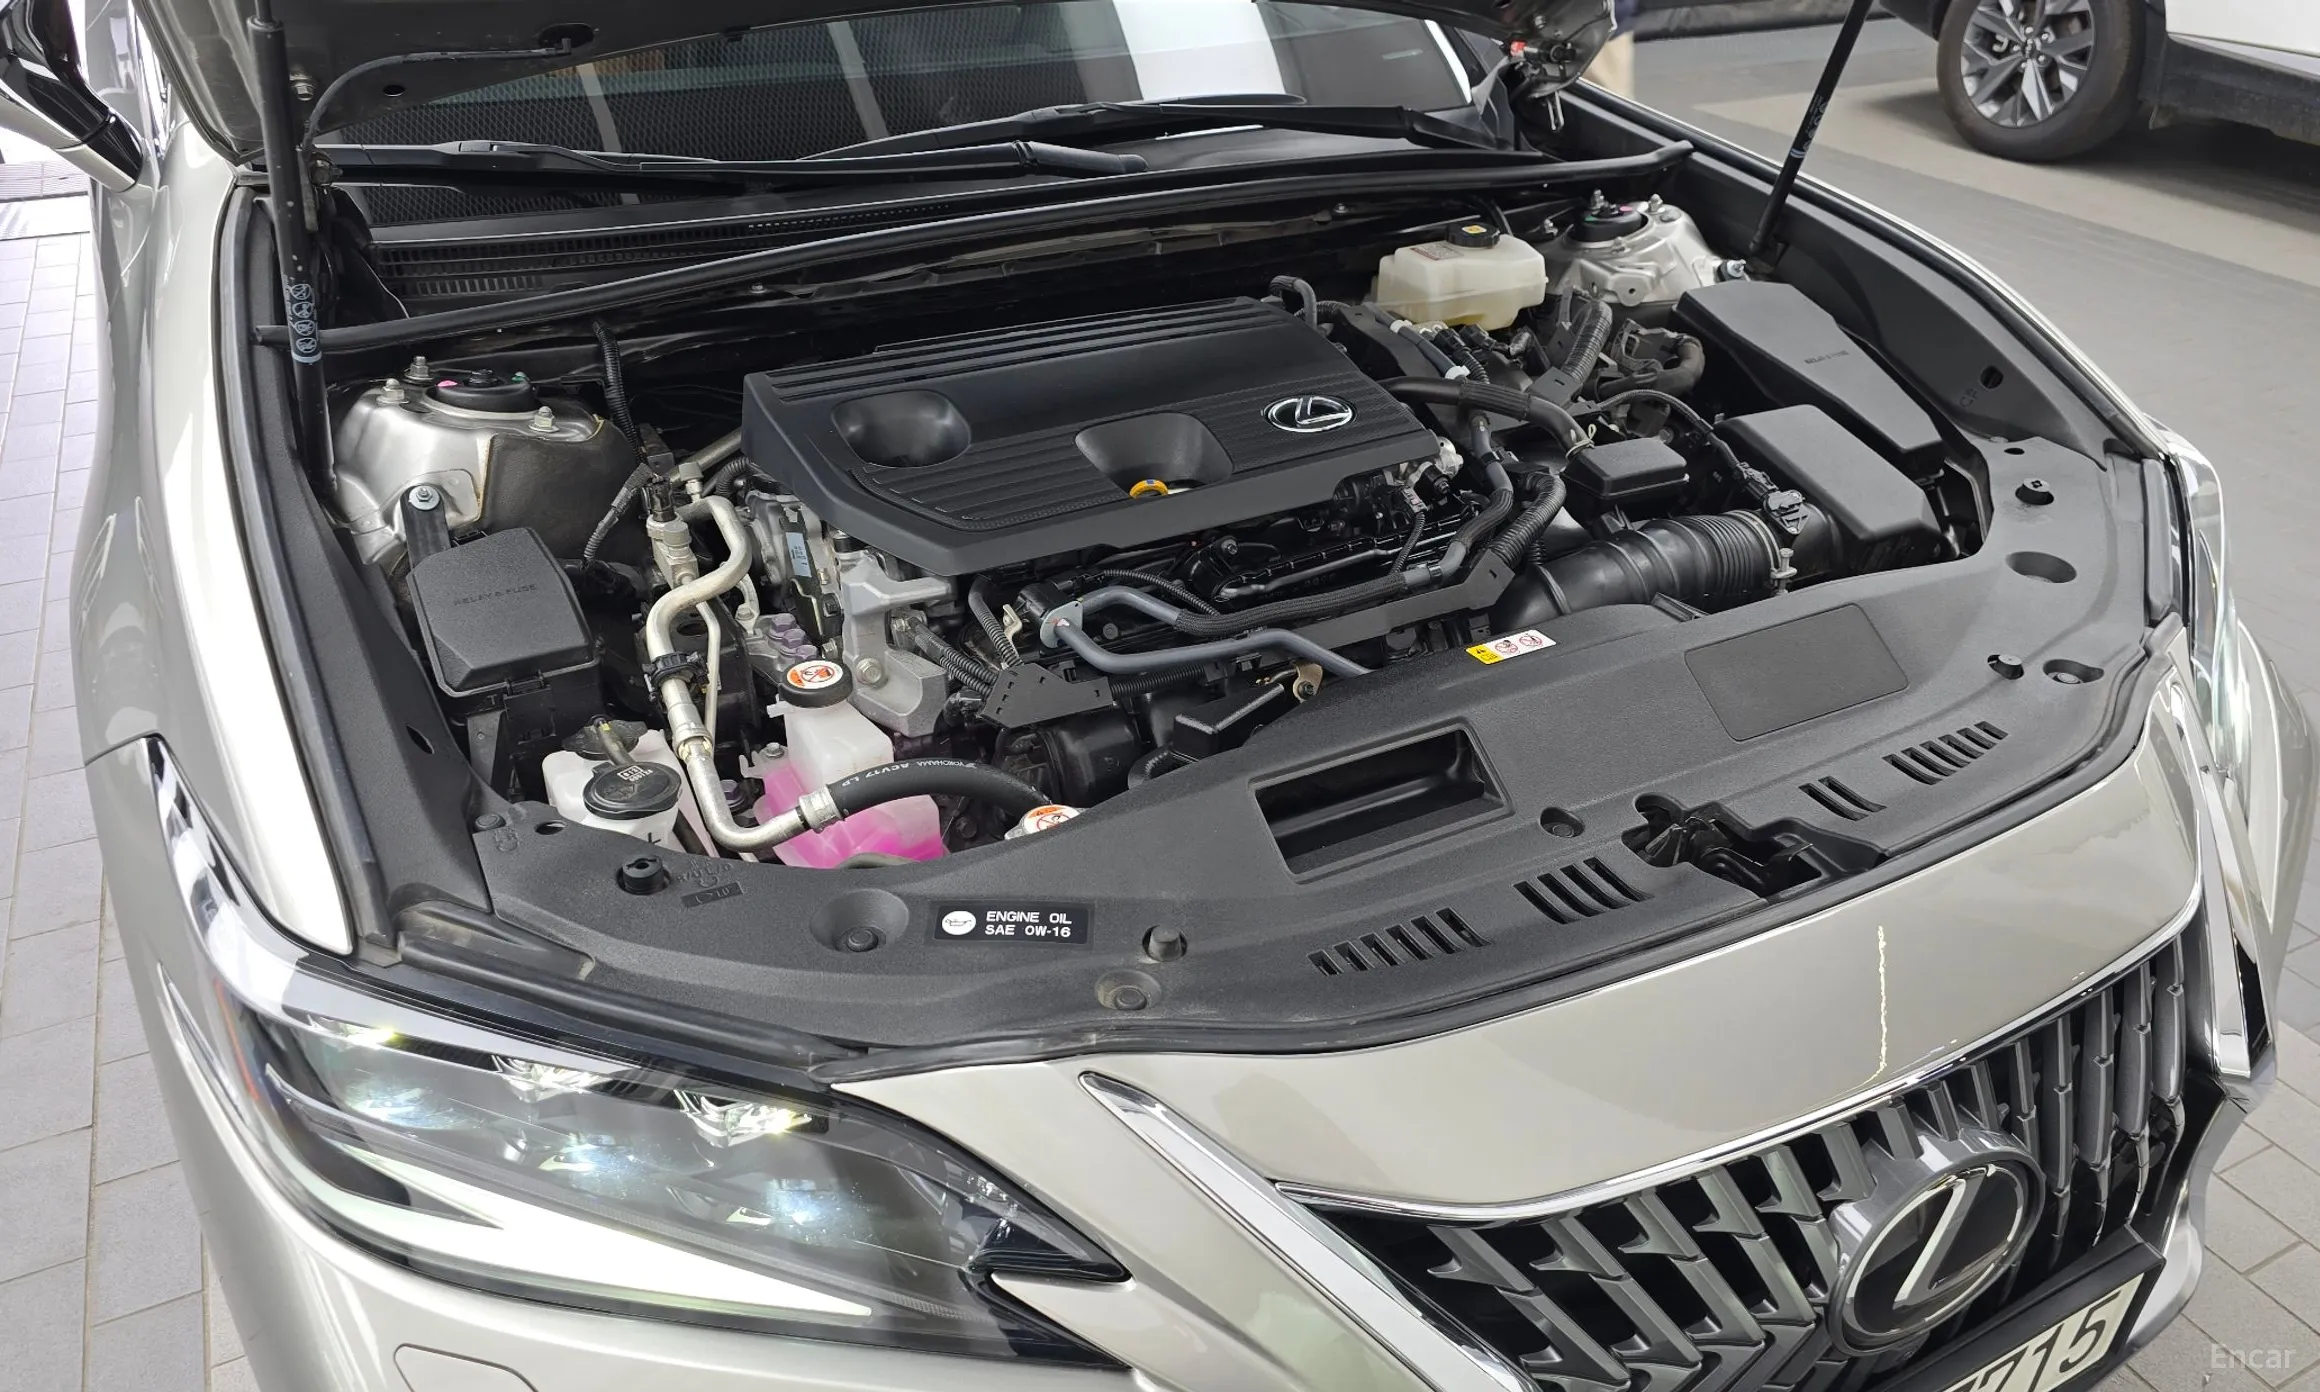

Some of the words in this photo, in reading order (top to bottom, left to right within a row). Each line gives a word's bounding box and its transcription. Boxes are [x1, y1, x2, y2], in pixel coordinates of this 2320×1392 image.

[916, 760, 965, 768] YOKOHAMA
[986, 910, 1040, 923] ENGINE
[1049, 913, 1072, 925] OIL
[985, 924, 1016, 935] SAE
[1024, 925, 1071, 938] 0W-16
[1951, 1290, 2121, 1392] 715
